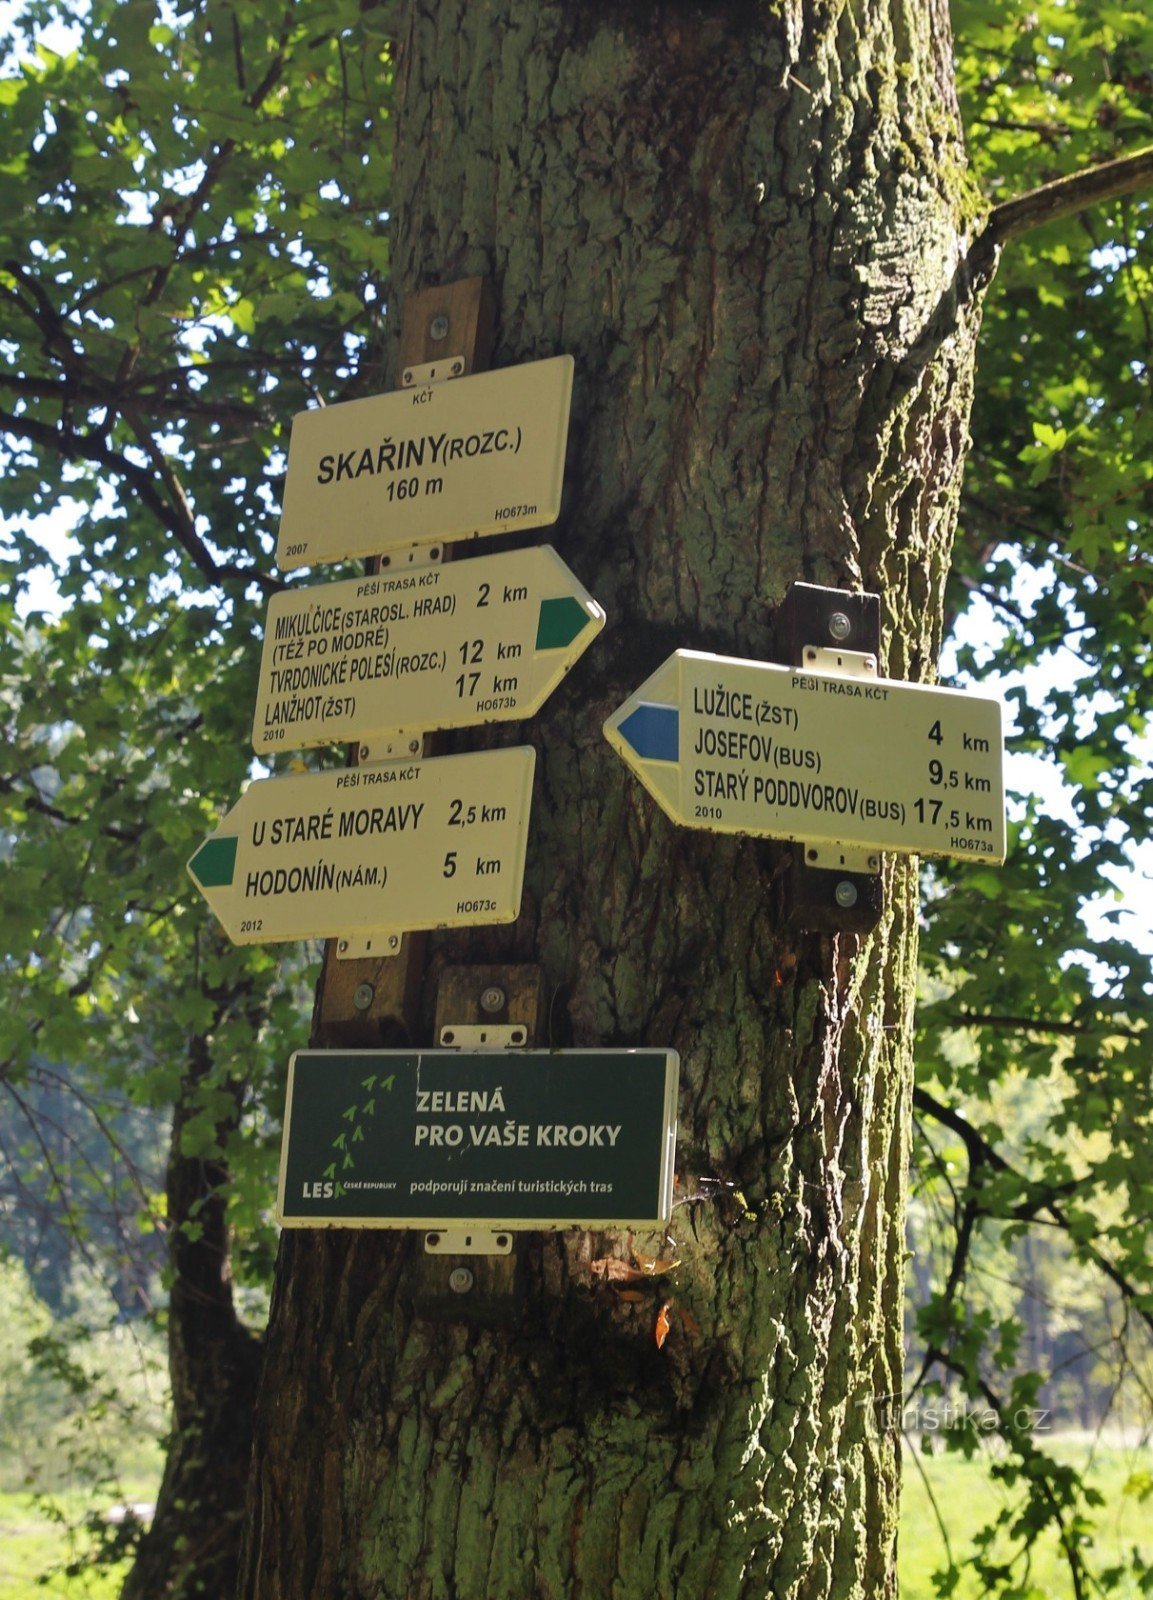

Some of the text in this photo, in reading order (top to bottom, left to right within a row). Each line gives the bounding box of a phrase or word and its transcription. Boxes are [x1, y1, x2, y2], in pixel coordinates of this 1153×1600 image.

[412, 391, 433, 405] KČT
[386, 478, 443, 501] 160 m
[495, 504, 536, 520] HO673m
[286, 543, 308, 556] 2007
[383, 578, 416, 592] TRASA
[419, 573, 440, 586] KČT
[413, 594, 456, 617] HRAD)
[477, 583, 490, 607] 2
[503, 584, 527, 603] km
[272, 625, 389, 666] (TÉŽ PO MODRÉ)
[270, 653, 347, 694] TVRDONICKÉ
[459, 640, 484, 665] 12
[497, 643, 521, 660] km
[455, 673, 481, 698] 17
[493, 676, 518, 694] km
[823, 681, 862, 697] TRASA
[865, 687, 889, 700] KČT
[476, 698, 516, 712] HO673b
[263, 729, 285, 742] 2010
[927, 720, 943, 746] 4
[963, 733, 989, 752] km
[363, 771, 396, 785] TRASA
[399, 766, 421, 780] KČT
[928, 759, 959, 790] 9,5
[965, 772, 991, 792] km
[694, 769, 749, 801] STARÝ
[913, 798, 960, 830] 17,5
[966, 813, 992, 832] km
[694, 805, 722, 819] 2010
[253, 799, 506, 846] U STARÉ MORAVY 2,5 km
[950, 837, 993, 853] HO673a
[443, 852, 457, 878] 5
[476, 858, 501, 875] km
[456, 901, 496, 914] HO673c
[241, 920, 263, 933] 2012
[416, 1087, 506, 1112] ZELENÁ
[414, 1121, 622, 1146] PRO VAŠE KROKY
[410, 1179, 613, 1195] podporují značení turistických tras
